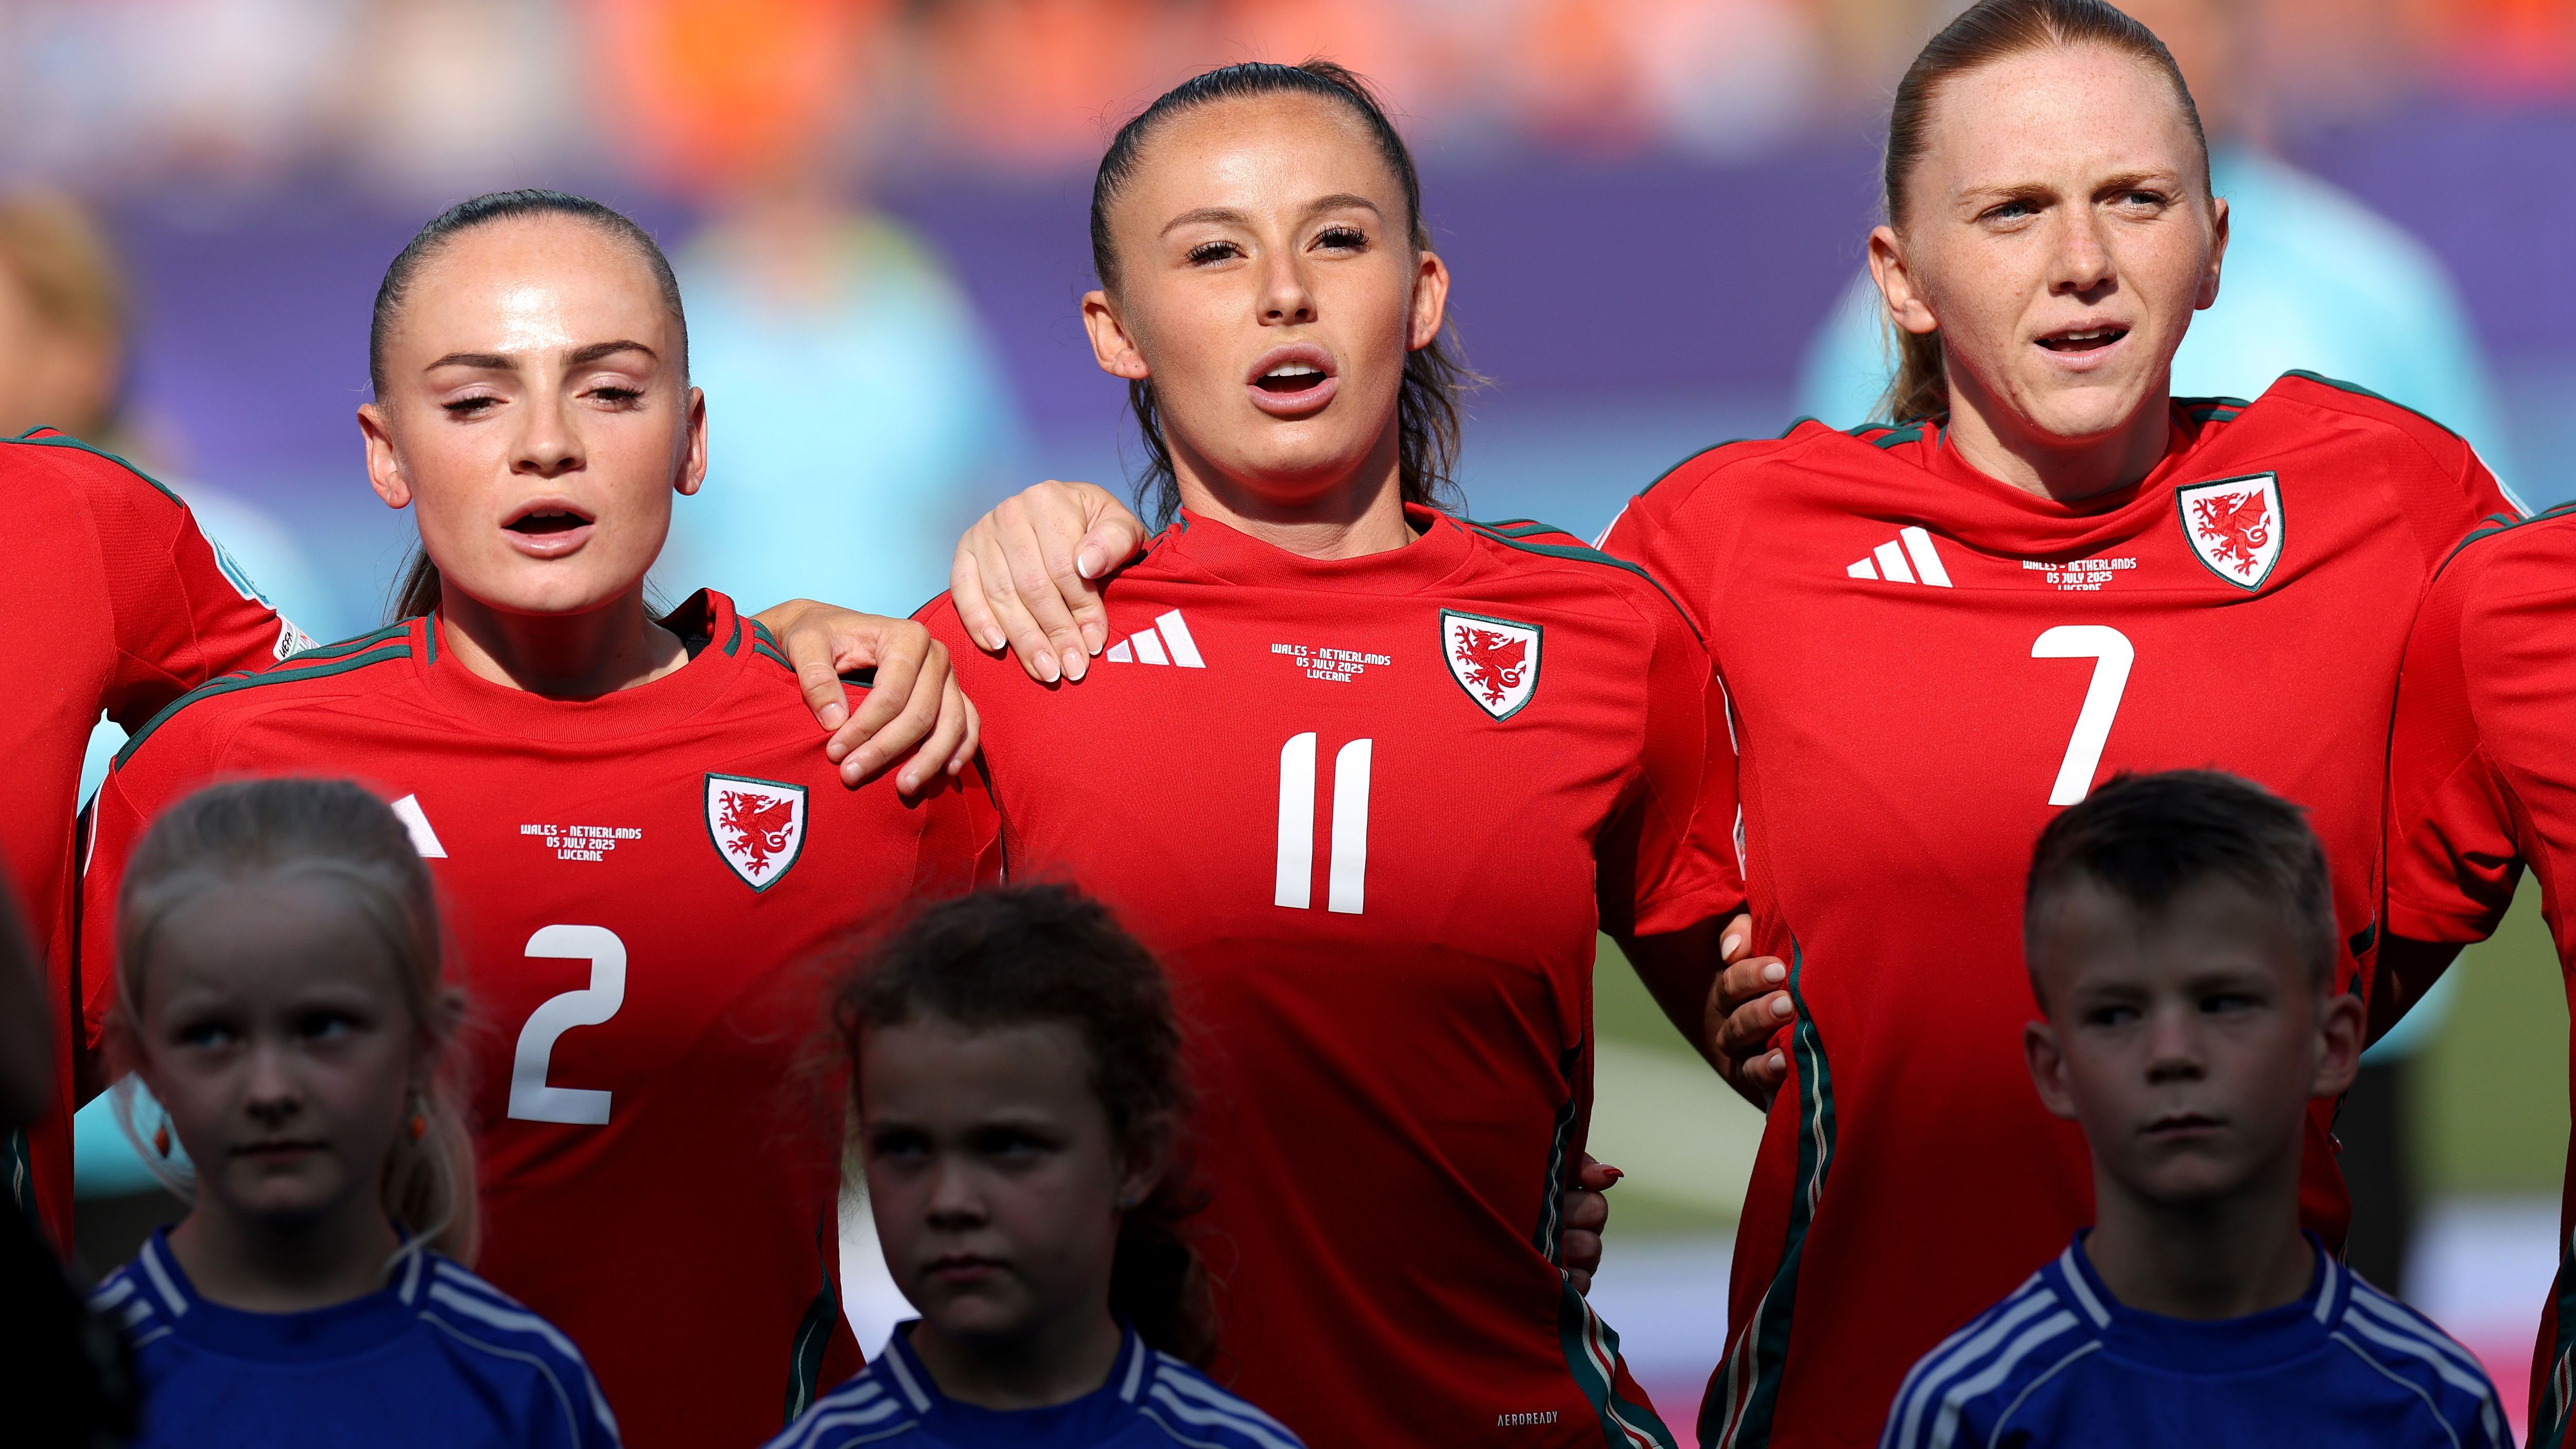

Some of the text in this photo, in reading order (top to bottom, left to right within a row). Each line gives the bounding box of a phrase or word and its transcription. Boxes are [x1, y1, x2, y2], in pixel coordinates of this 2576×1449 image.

[2068, 557, 2137, 572] NETHERLANDS
[2046, 570, 2113, 584] 05 JULY 2025
[279, 631, 293, 658] UEFA
[1271, 643, 1308, 656] WALES
[1319, 648, 1391, 666] NETHERLANDS
[1296, 657, 1364, 674] 05 JULY 2025
[1307, 669, 1352, 683] LUCERNE
[2031, 625, 2135, 806] 7
[1274, 732, 1372, 915] 11
[520, 824, 558, 836] WALES
[569, 825, 642, 840] NETHERLANDS
[546, 836, 616, 850] 05 JULY 2025
[558, 849, 603, 862] LUCERNE
[507, 924, 627, 1125] 2
[1497, 1411, 1558, 1427] AEROREADY
